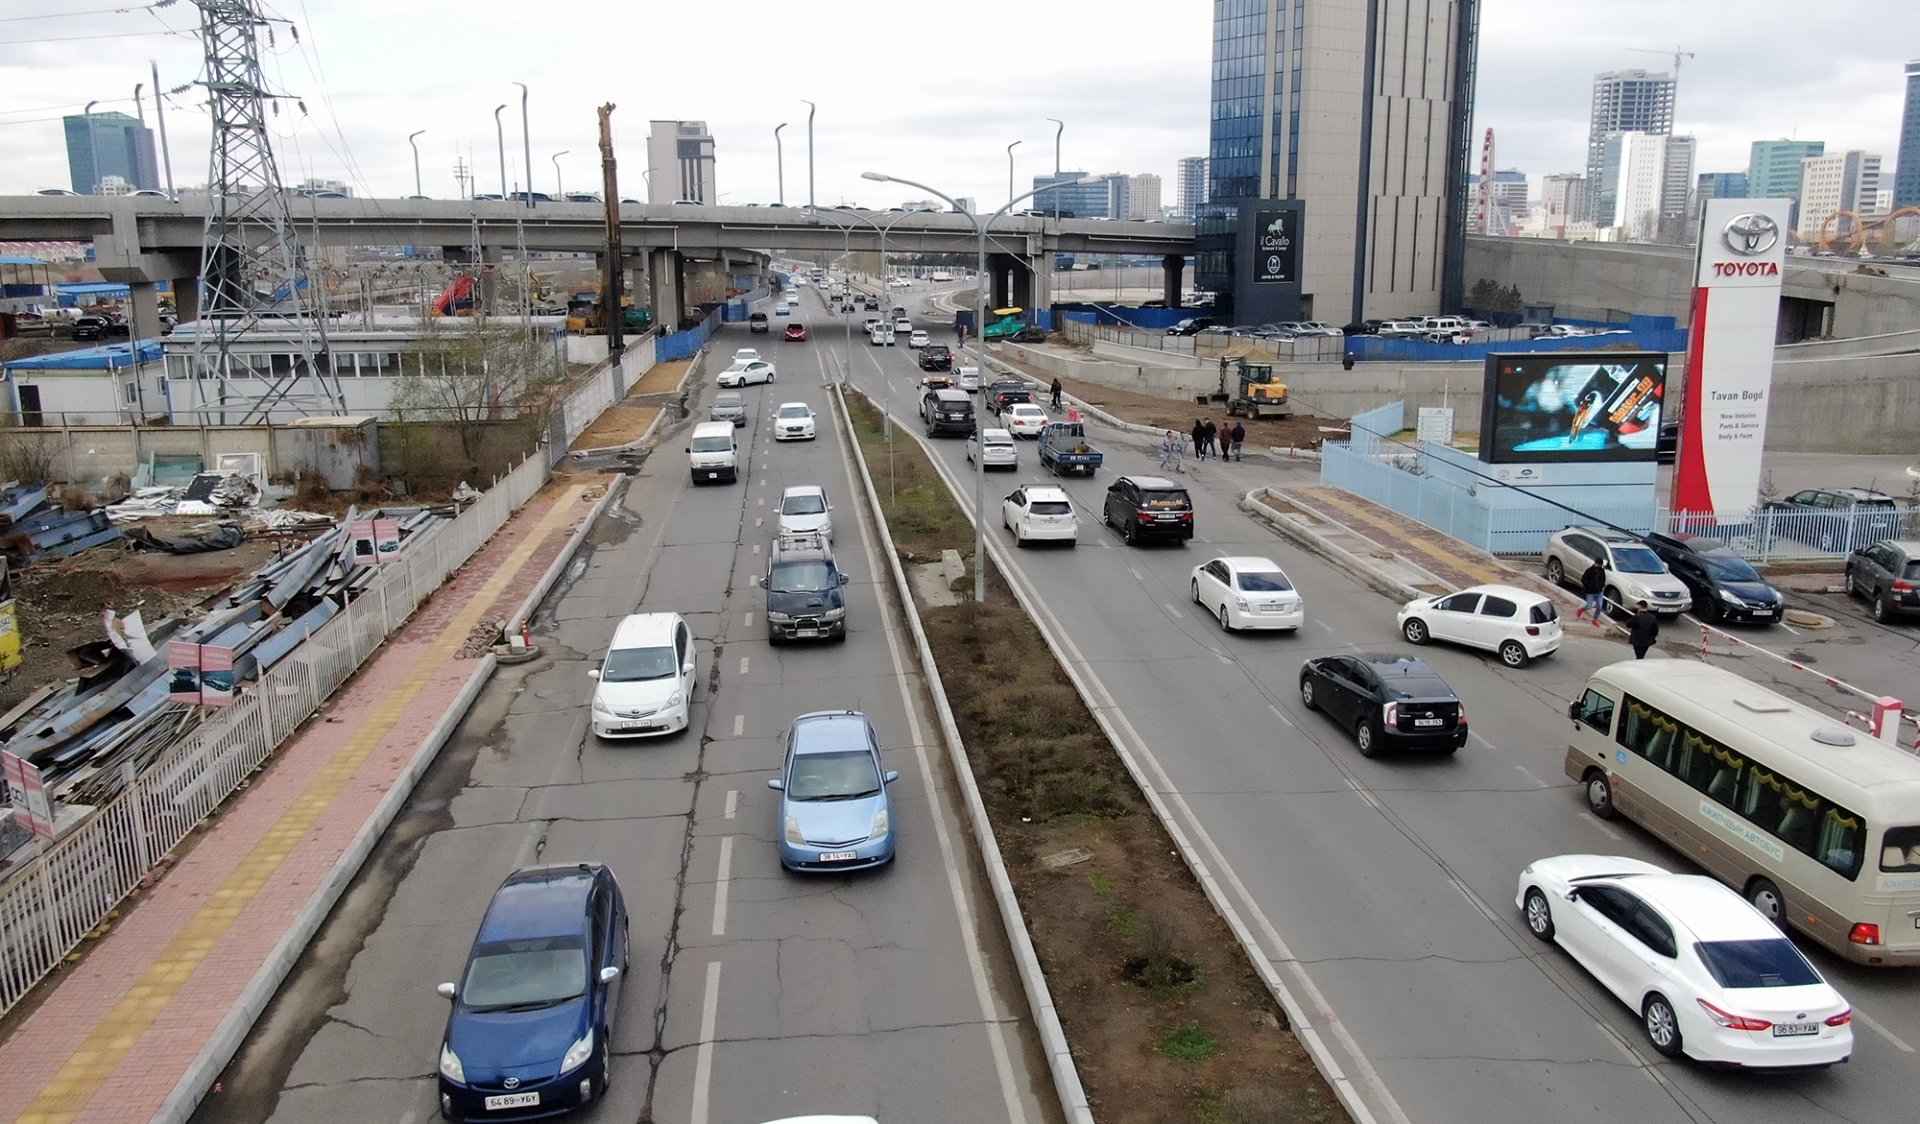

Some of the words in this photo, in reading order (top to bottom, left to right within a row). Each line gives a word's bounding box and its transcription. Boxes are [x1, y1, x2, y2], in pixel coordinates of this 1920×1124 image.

[1713, 262, 1778, 277] TOYOTA
[1711, 391, 1738, 400] Tavan
[1742, 390, 1763, 402] Bogd
